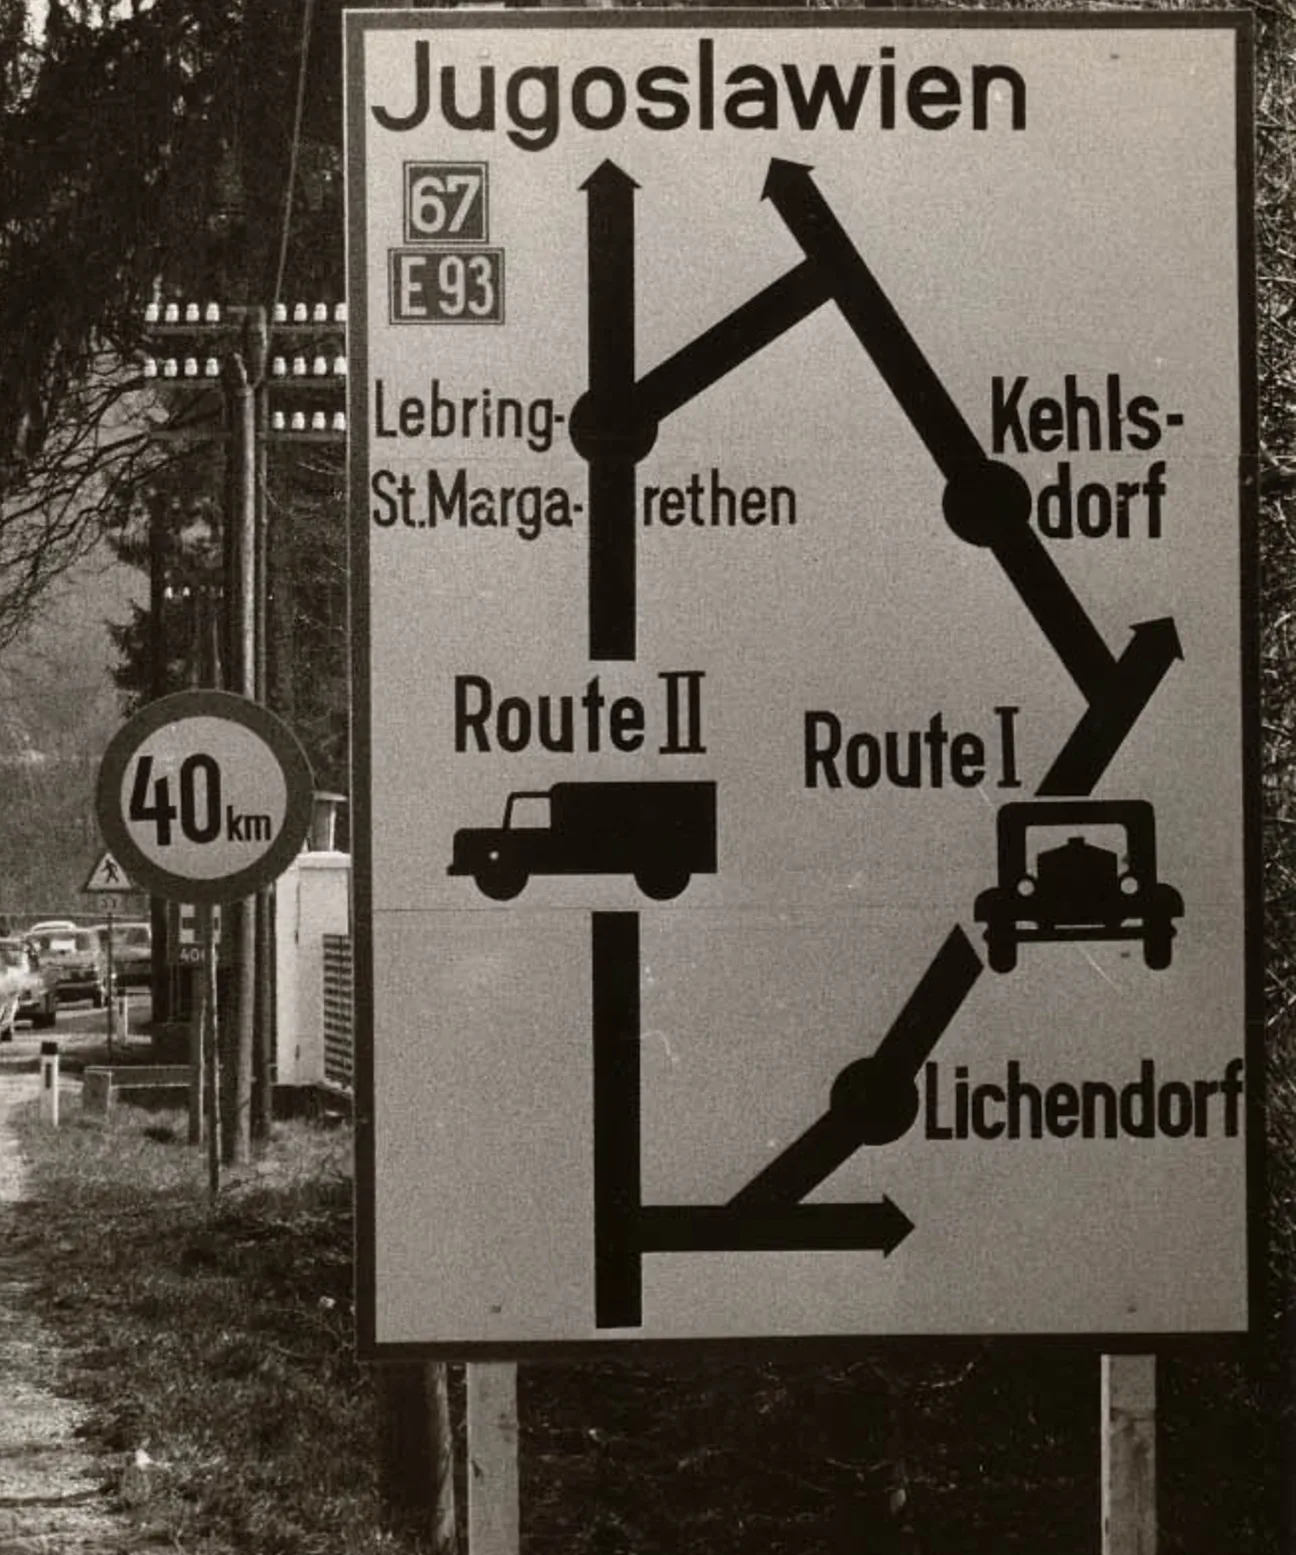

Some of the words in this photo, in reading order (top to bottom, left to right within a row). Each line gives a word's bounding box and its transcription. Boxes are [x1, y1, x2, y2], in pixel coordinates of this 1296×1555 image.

[371, 39, 1027, 153] Jugoslawien
[411, 175, 481, 233] 67
[401, 256, 427, 316] E
[438, 255, 494, 316] 93
[375, 379, 565, 453] Lebring-
[991, 373, 1184, 454] Kehls-
[643, 467, 797, 527] rethen
[1037, 461, 1167, 540] dorf
[454, 674, 646, 754] Route
[657, 671, 707, 754] II
[804, 706, 986, 789] Route
[993, 706, 1022, 788] I
[128, 753, 222, 846] 40
[226, 804, 272, 842] km
[925, 1058, 1244, 1140] Lichendorf
